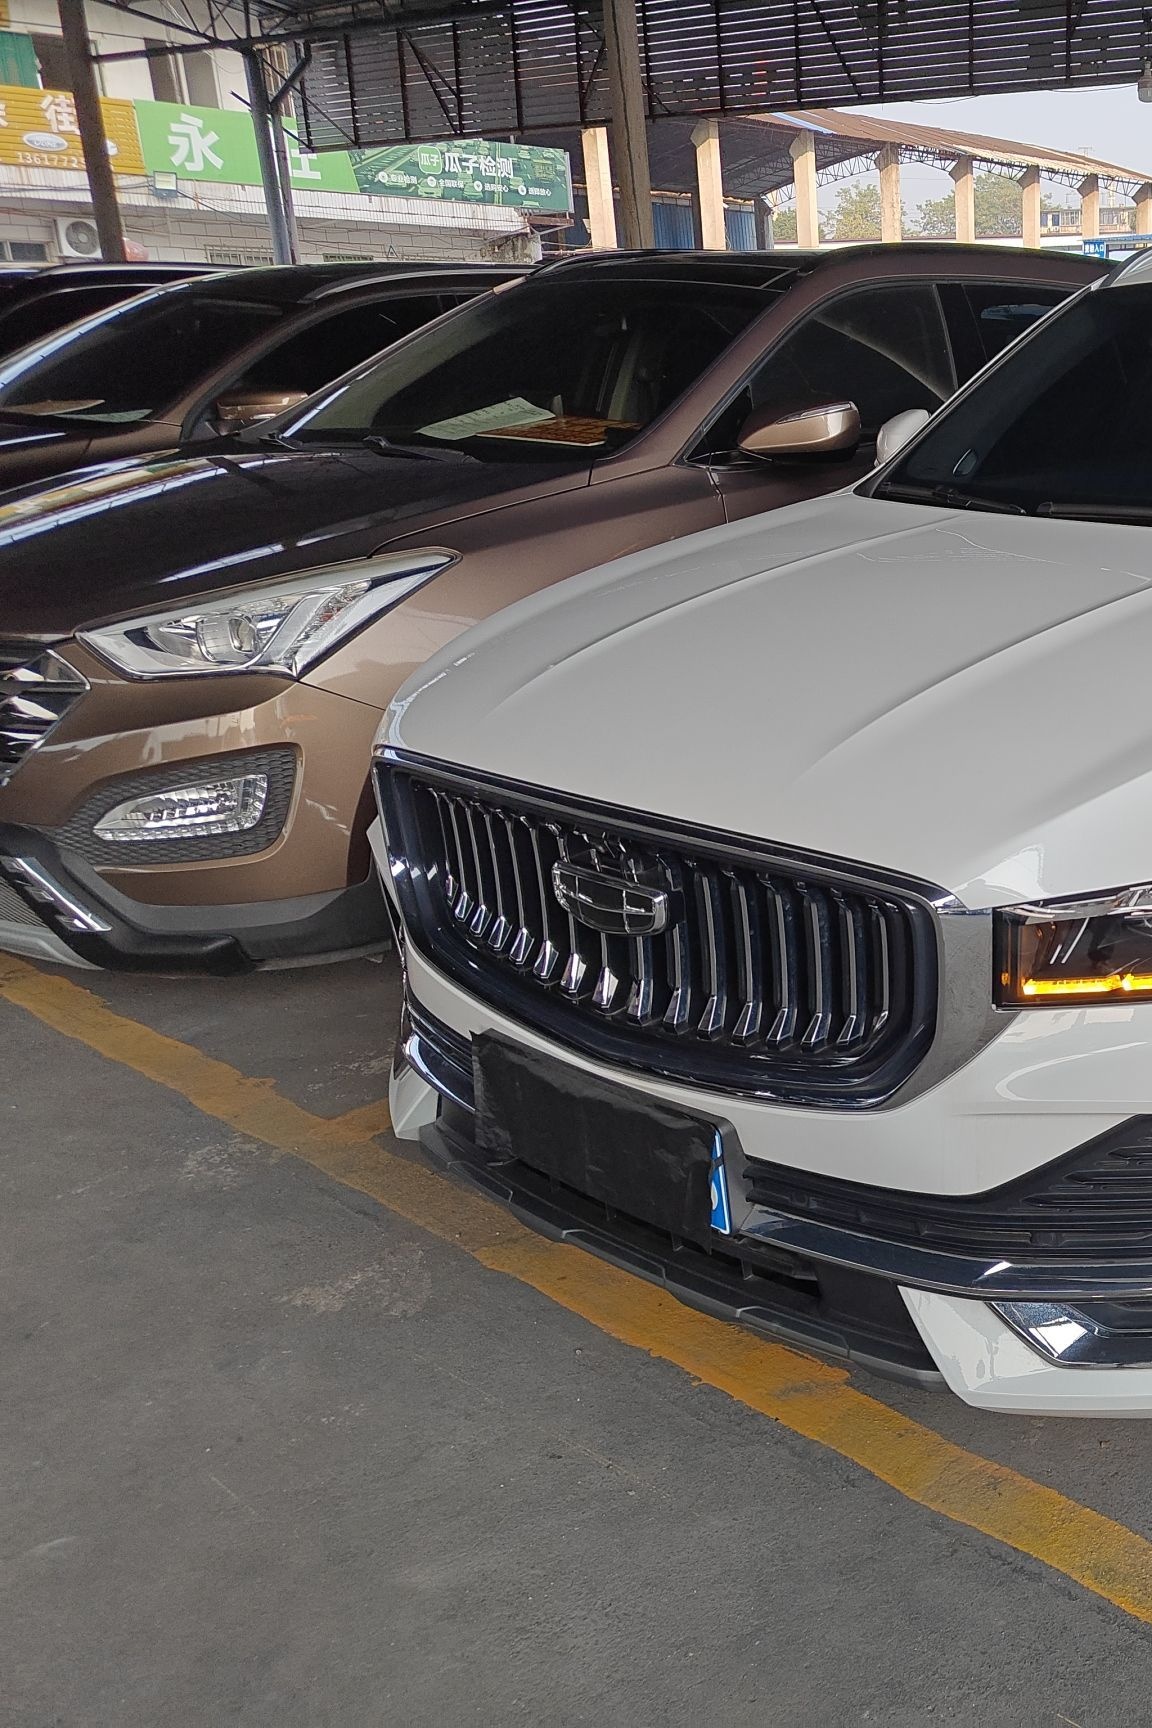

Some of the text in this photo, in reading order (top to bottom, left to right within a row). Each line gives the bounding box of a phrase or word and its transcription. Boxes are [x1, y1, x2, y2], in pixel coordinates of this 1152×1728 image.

[17, 152, 86, 169] 1361772
[420, 153, 440, 167] 瓜子
[444, 152, 514, 178] 瓜子检测
